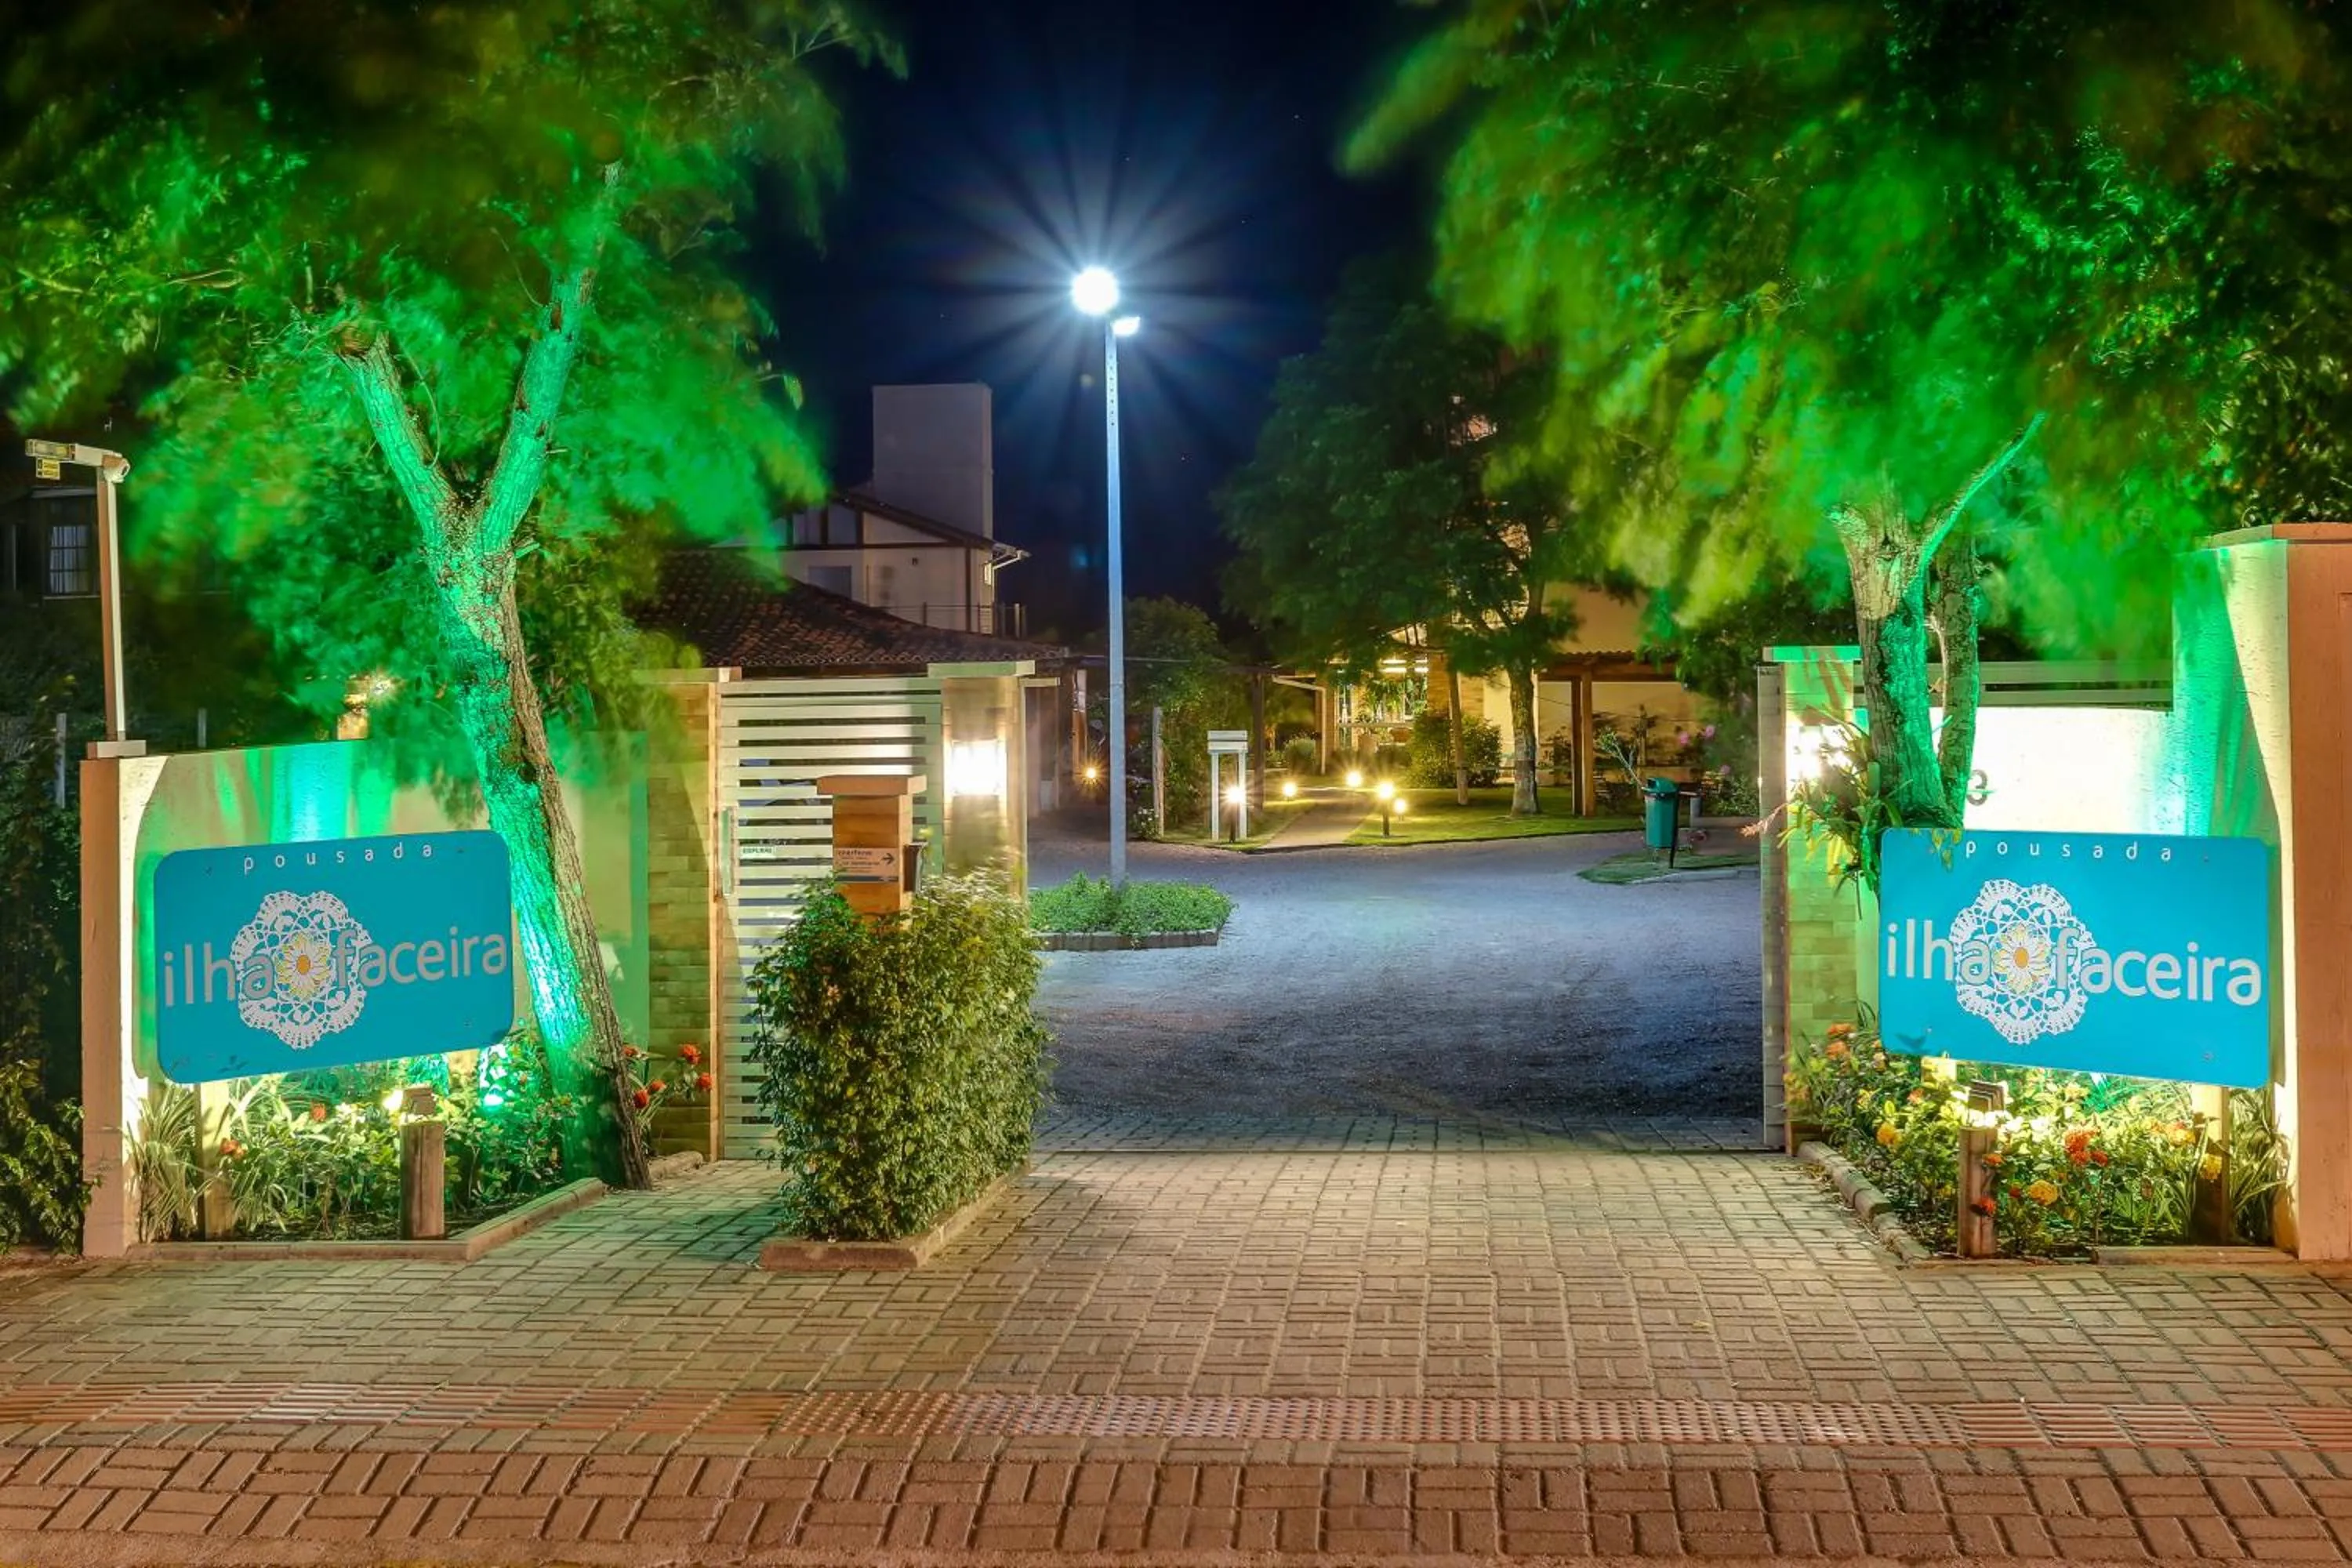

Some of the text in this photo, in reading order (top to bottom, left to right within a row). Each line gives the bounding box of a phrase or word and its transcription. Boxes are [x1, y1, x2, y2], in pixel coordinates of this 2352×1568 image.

[243, 842, 432, 874] pousada
[1966, 840, 2171, 862] pousada
[164, 927, 506, 1007] ilha faceira
[1887, 919, 2262, 1006] ilha faceira
